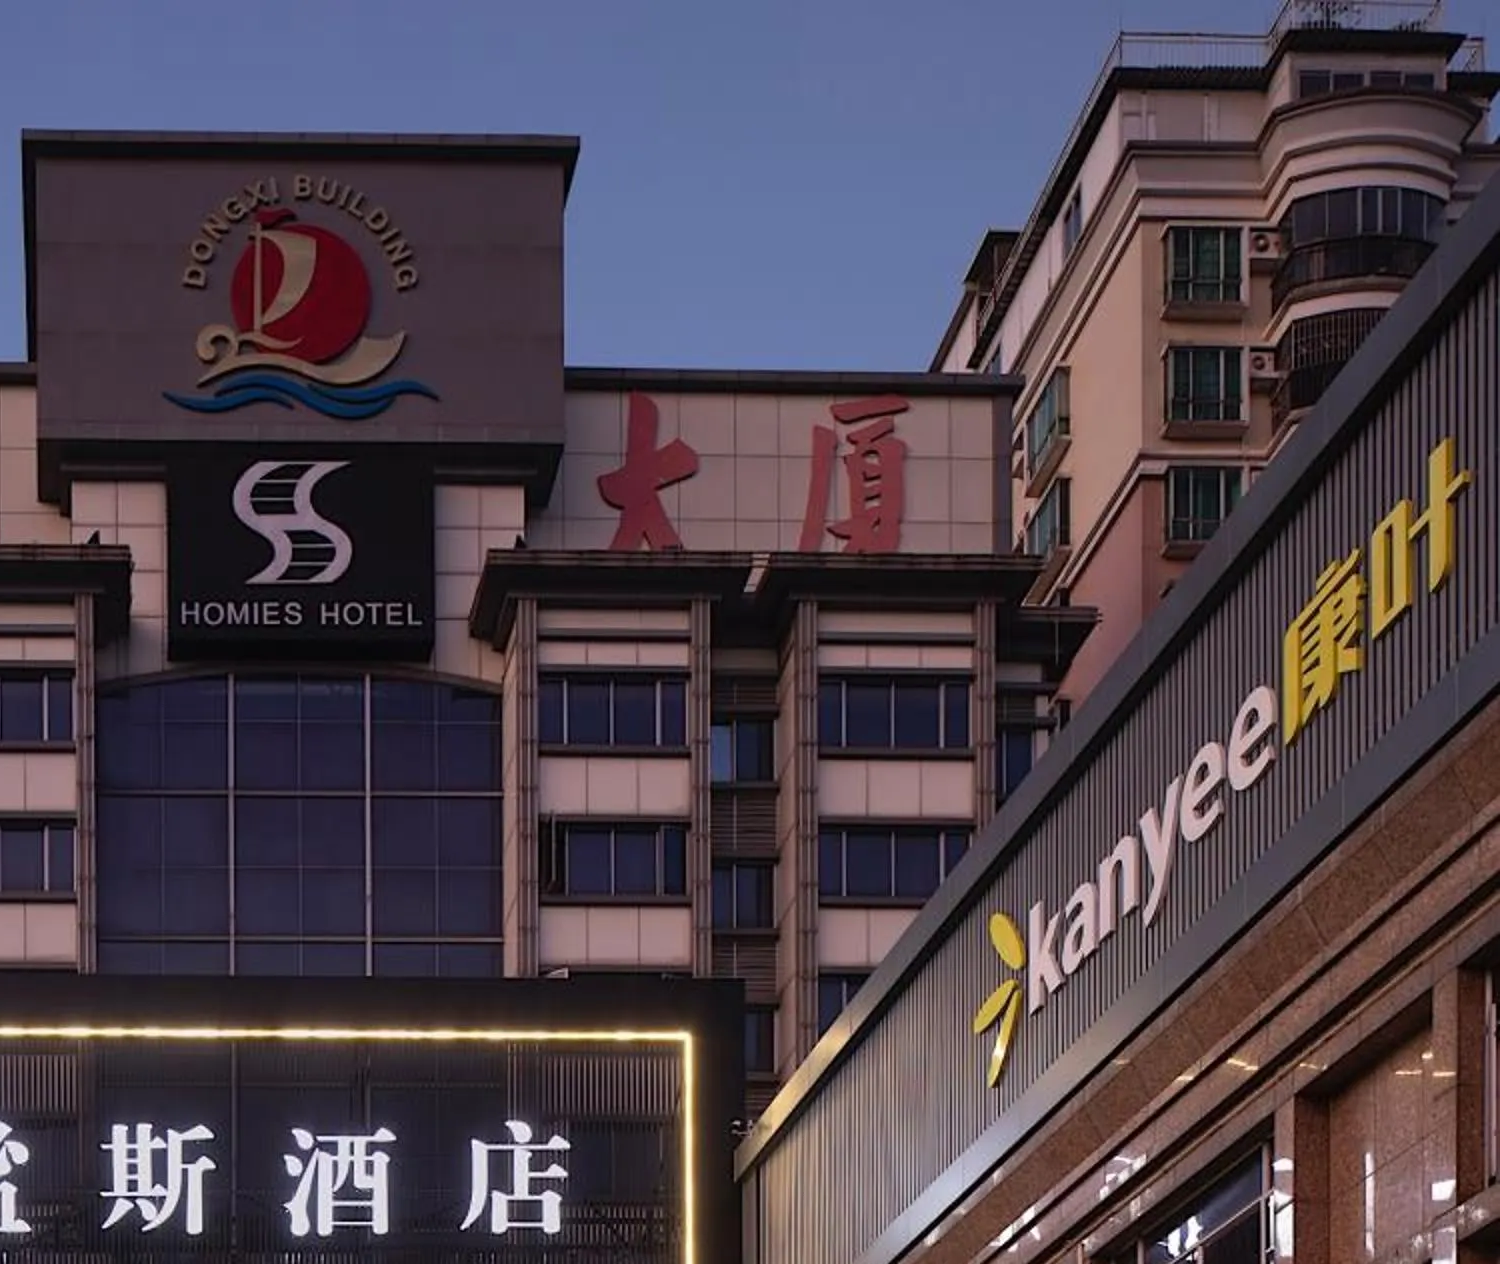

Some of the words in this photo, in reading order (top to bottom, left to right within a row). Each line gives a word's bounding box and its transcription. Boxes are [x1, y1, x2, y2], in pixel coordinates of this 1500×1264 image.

[182, 176, 280, 291] DONGXI
[292, 173, 420, 293] BUILDING
[180, 602, 302, 626] HOMIES
[320, 602, 423, 626] HOTEL
[1026, 684, 1277, 1016] kanyee
[1282, 437, 1474, 748] 康叶
